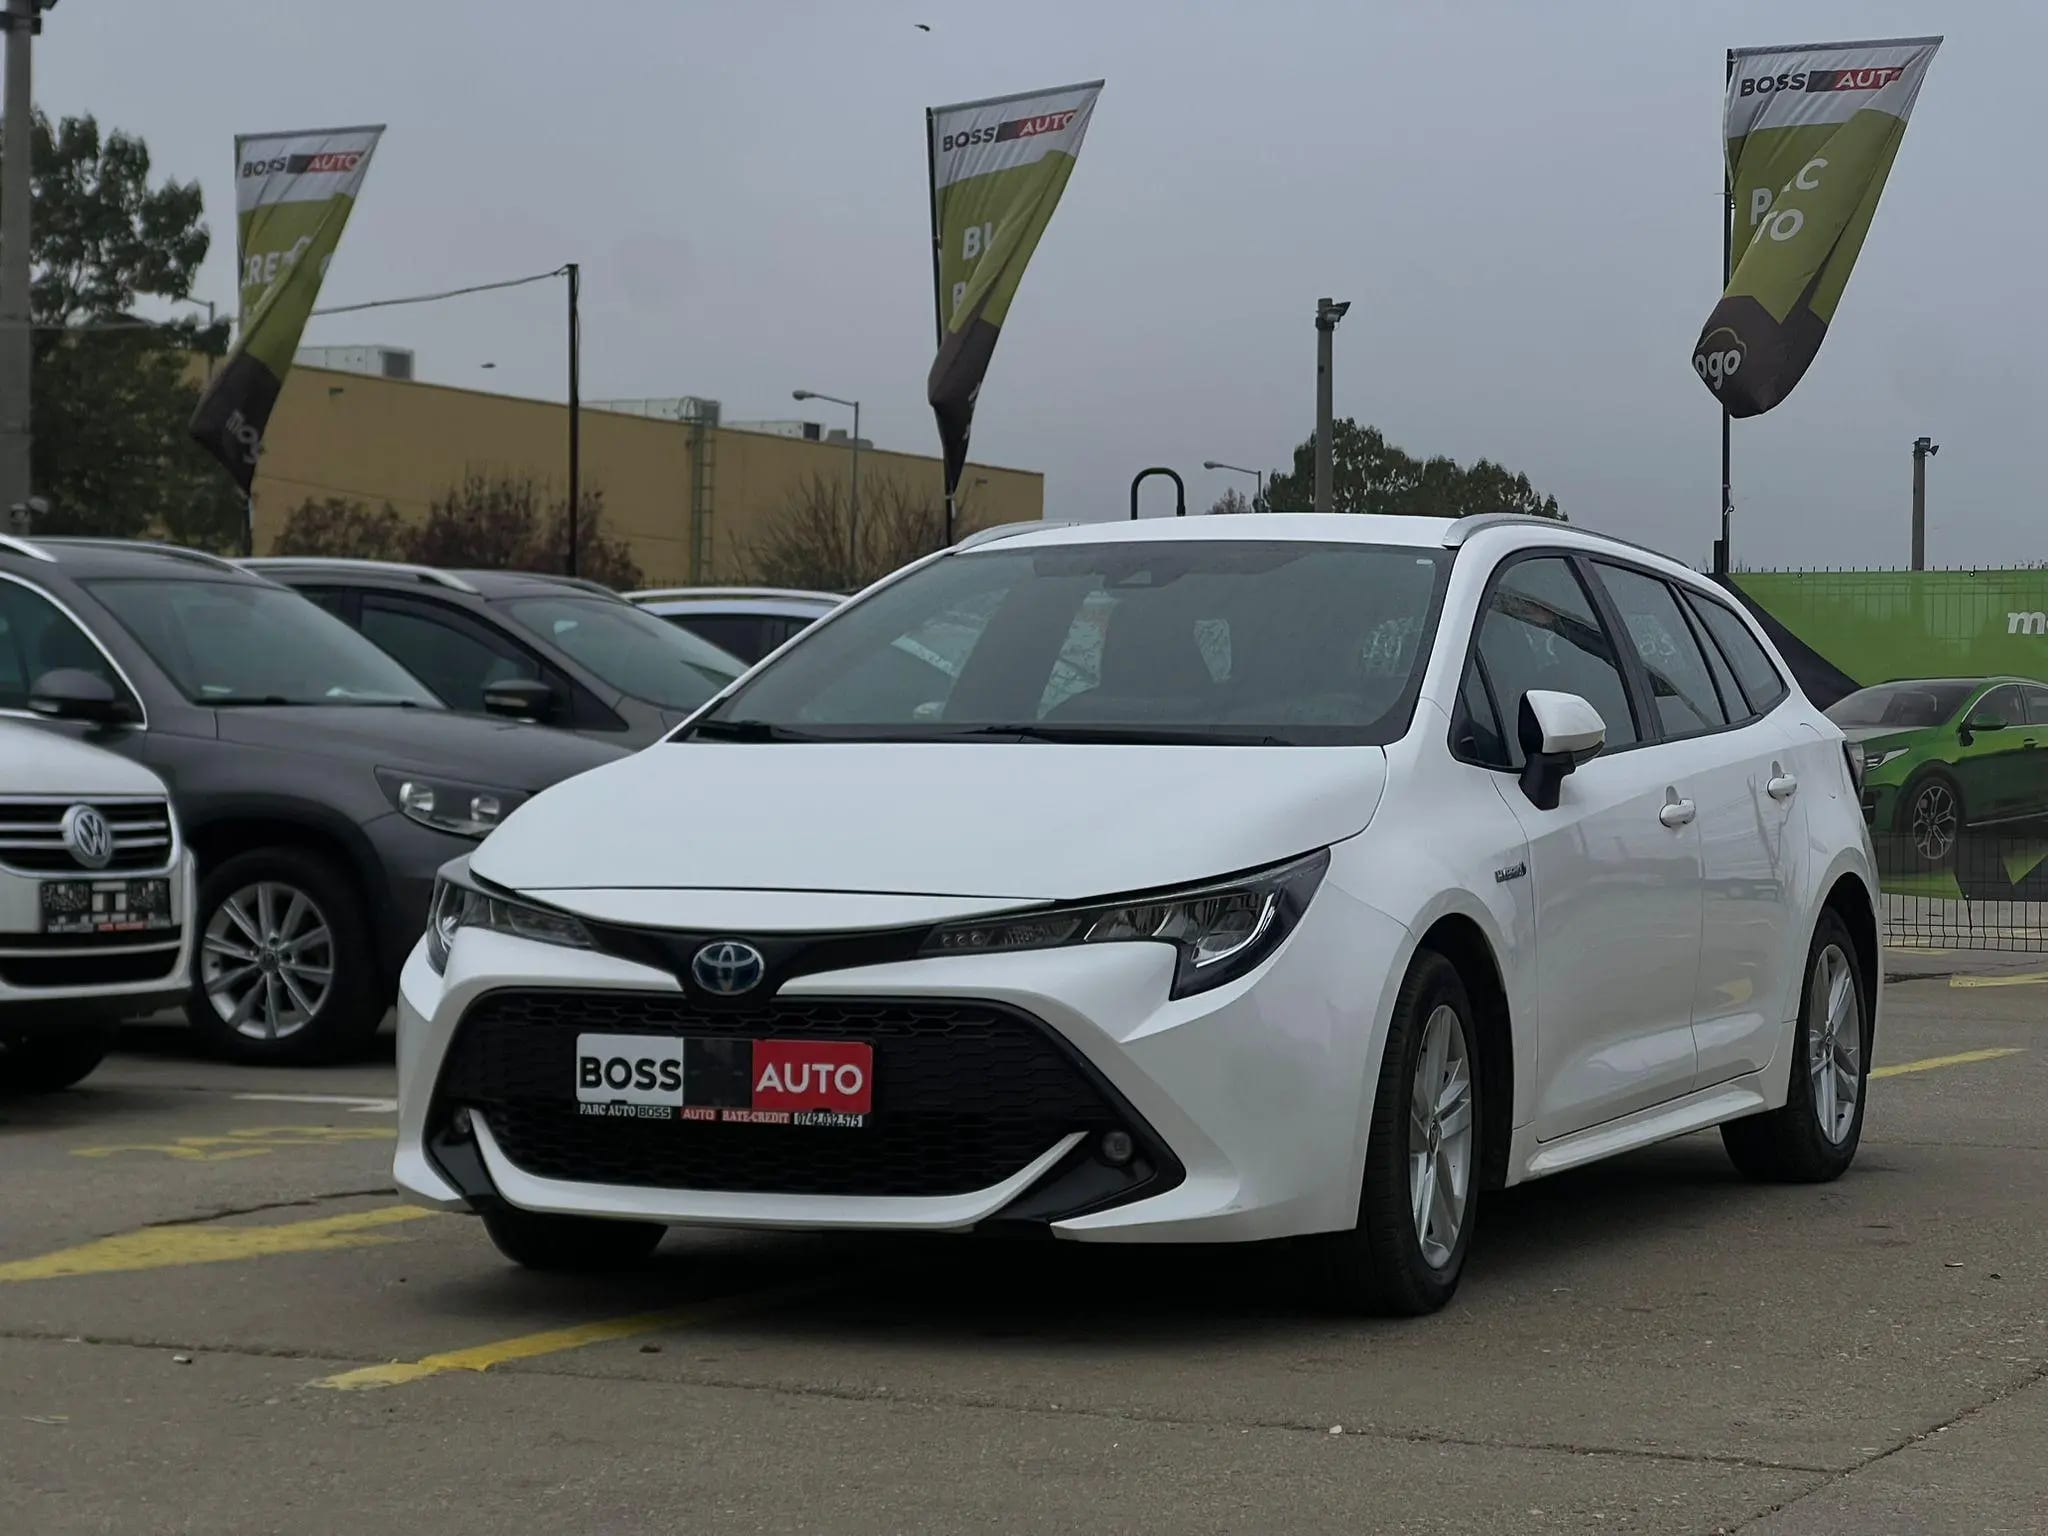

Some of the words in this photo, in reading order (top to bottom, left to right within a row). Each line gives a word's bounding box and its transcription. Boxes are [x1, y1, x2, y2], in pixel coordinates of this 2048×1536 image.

[1740, 72, 1807, 97] BOSS
[943, 126, 996, 152] BOSS
[308, 154, 359, 171] AUTO
[579, 1056, 682, 1092] BOSS
[755, 1062, 863, 1095] AUTO
[579, 1103, 606, 1116] PARC
[607, 1104, 636, 1117] AUTO
[638, 1106, 671, 1118] BOSS
[682, 1108, 715, 1121] AUTO
